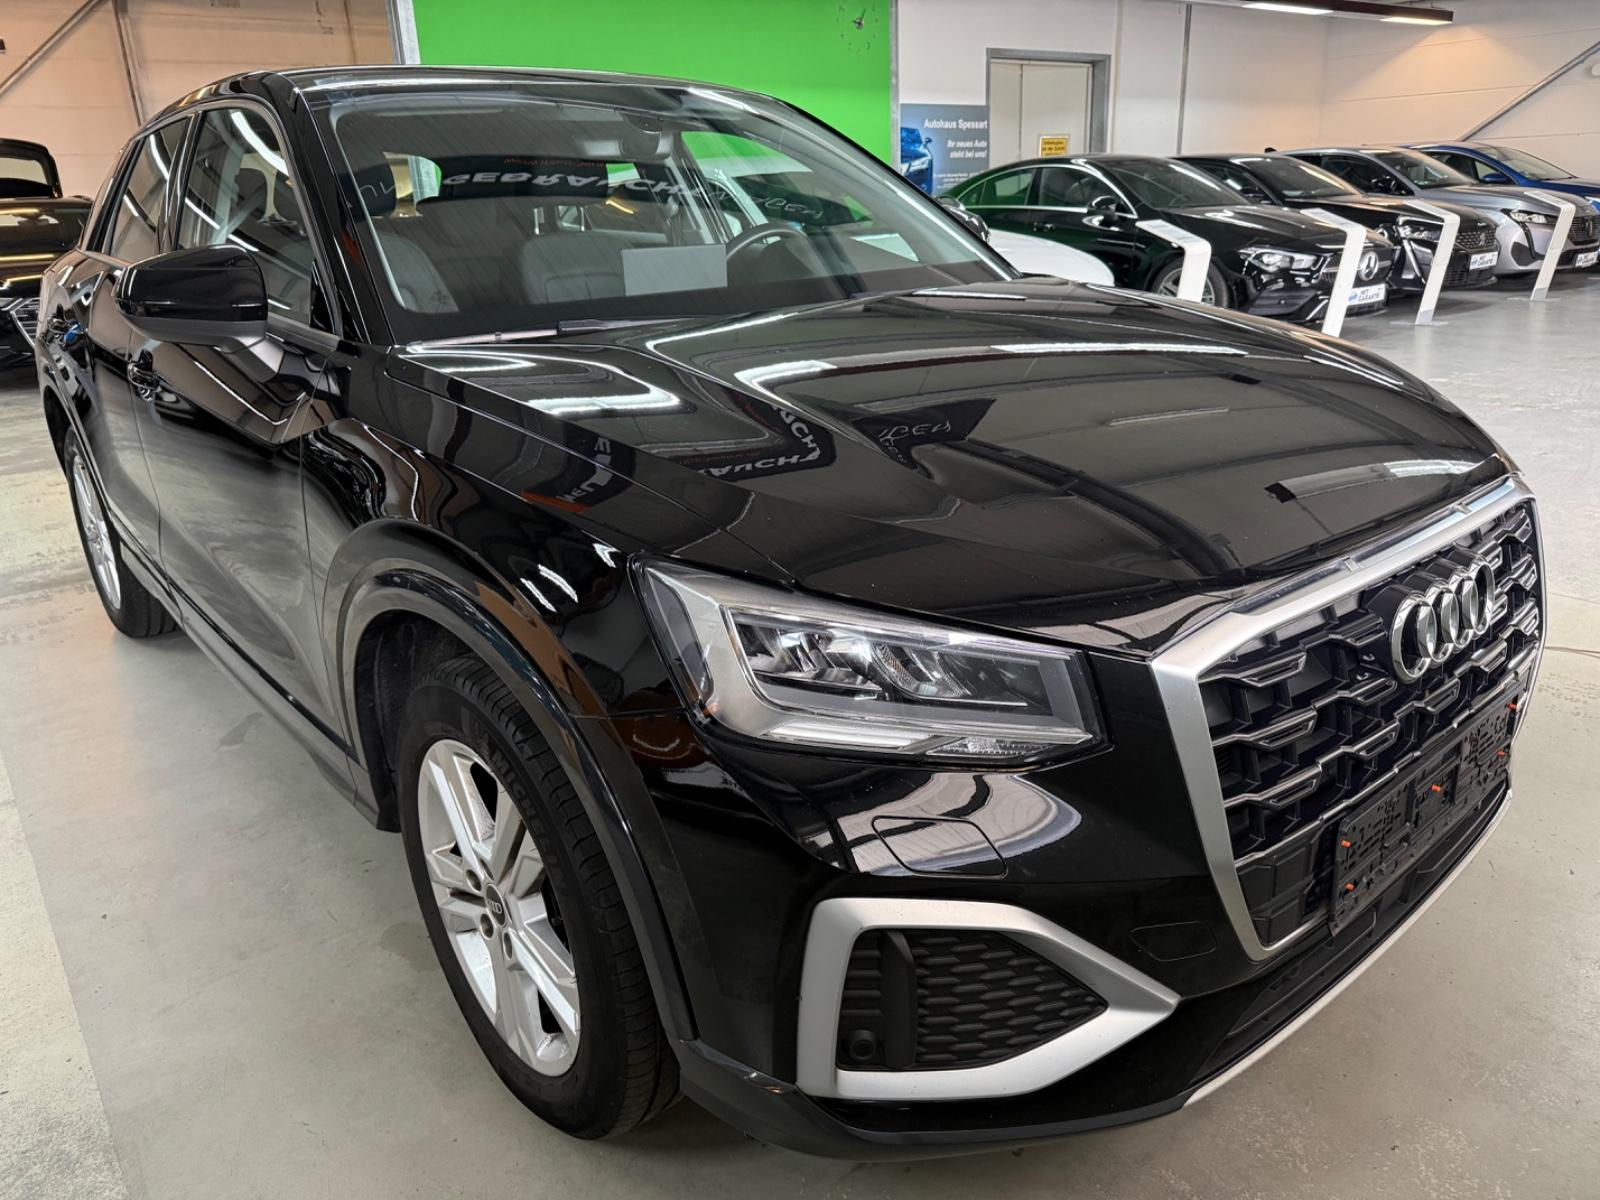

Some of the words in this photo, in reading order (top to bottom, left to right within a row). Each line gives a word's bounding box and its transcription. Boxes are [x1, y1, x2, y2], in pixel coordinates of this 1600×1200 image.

[924, 118, 957, 129] Autohaus
[958, 119, 988, 131] Spessart
[947, 139, 955, 148] Ihr
[974, 139, 987, 148] Auto
